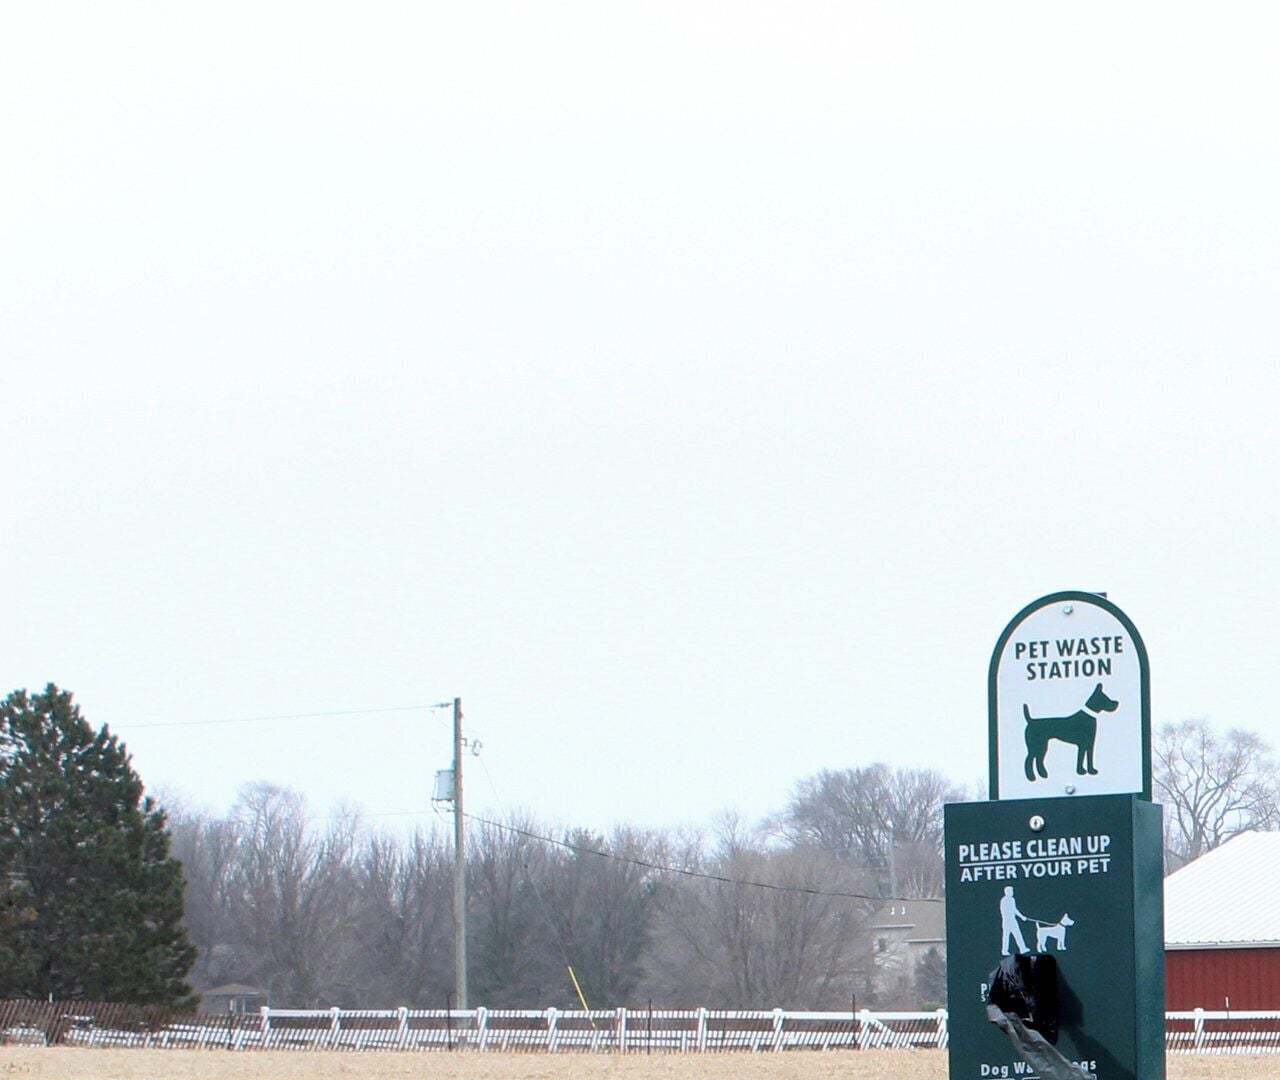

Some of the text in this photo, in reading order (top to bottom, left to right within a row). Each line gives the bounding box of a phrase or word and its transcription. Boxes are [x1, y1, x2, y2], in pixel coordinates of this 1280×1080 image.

[1015, 636, 1123, 660] PET WASTE
[1026, 658, 1112, 681] STATION
[958, 834, 1111, 863] PLEASE CLEAN UP
[960, 858, 1111, 883] AFTER YOUR PET
[980, 1063, 1009, 1078] Dog
